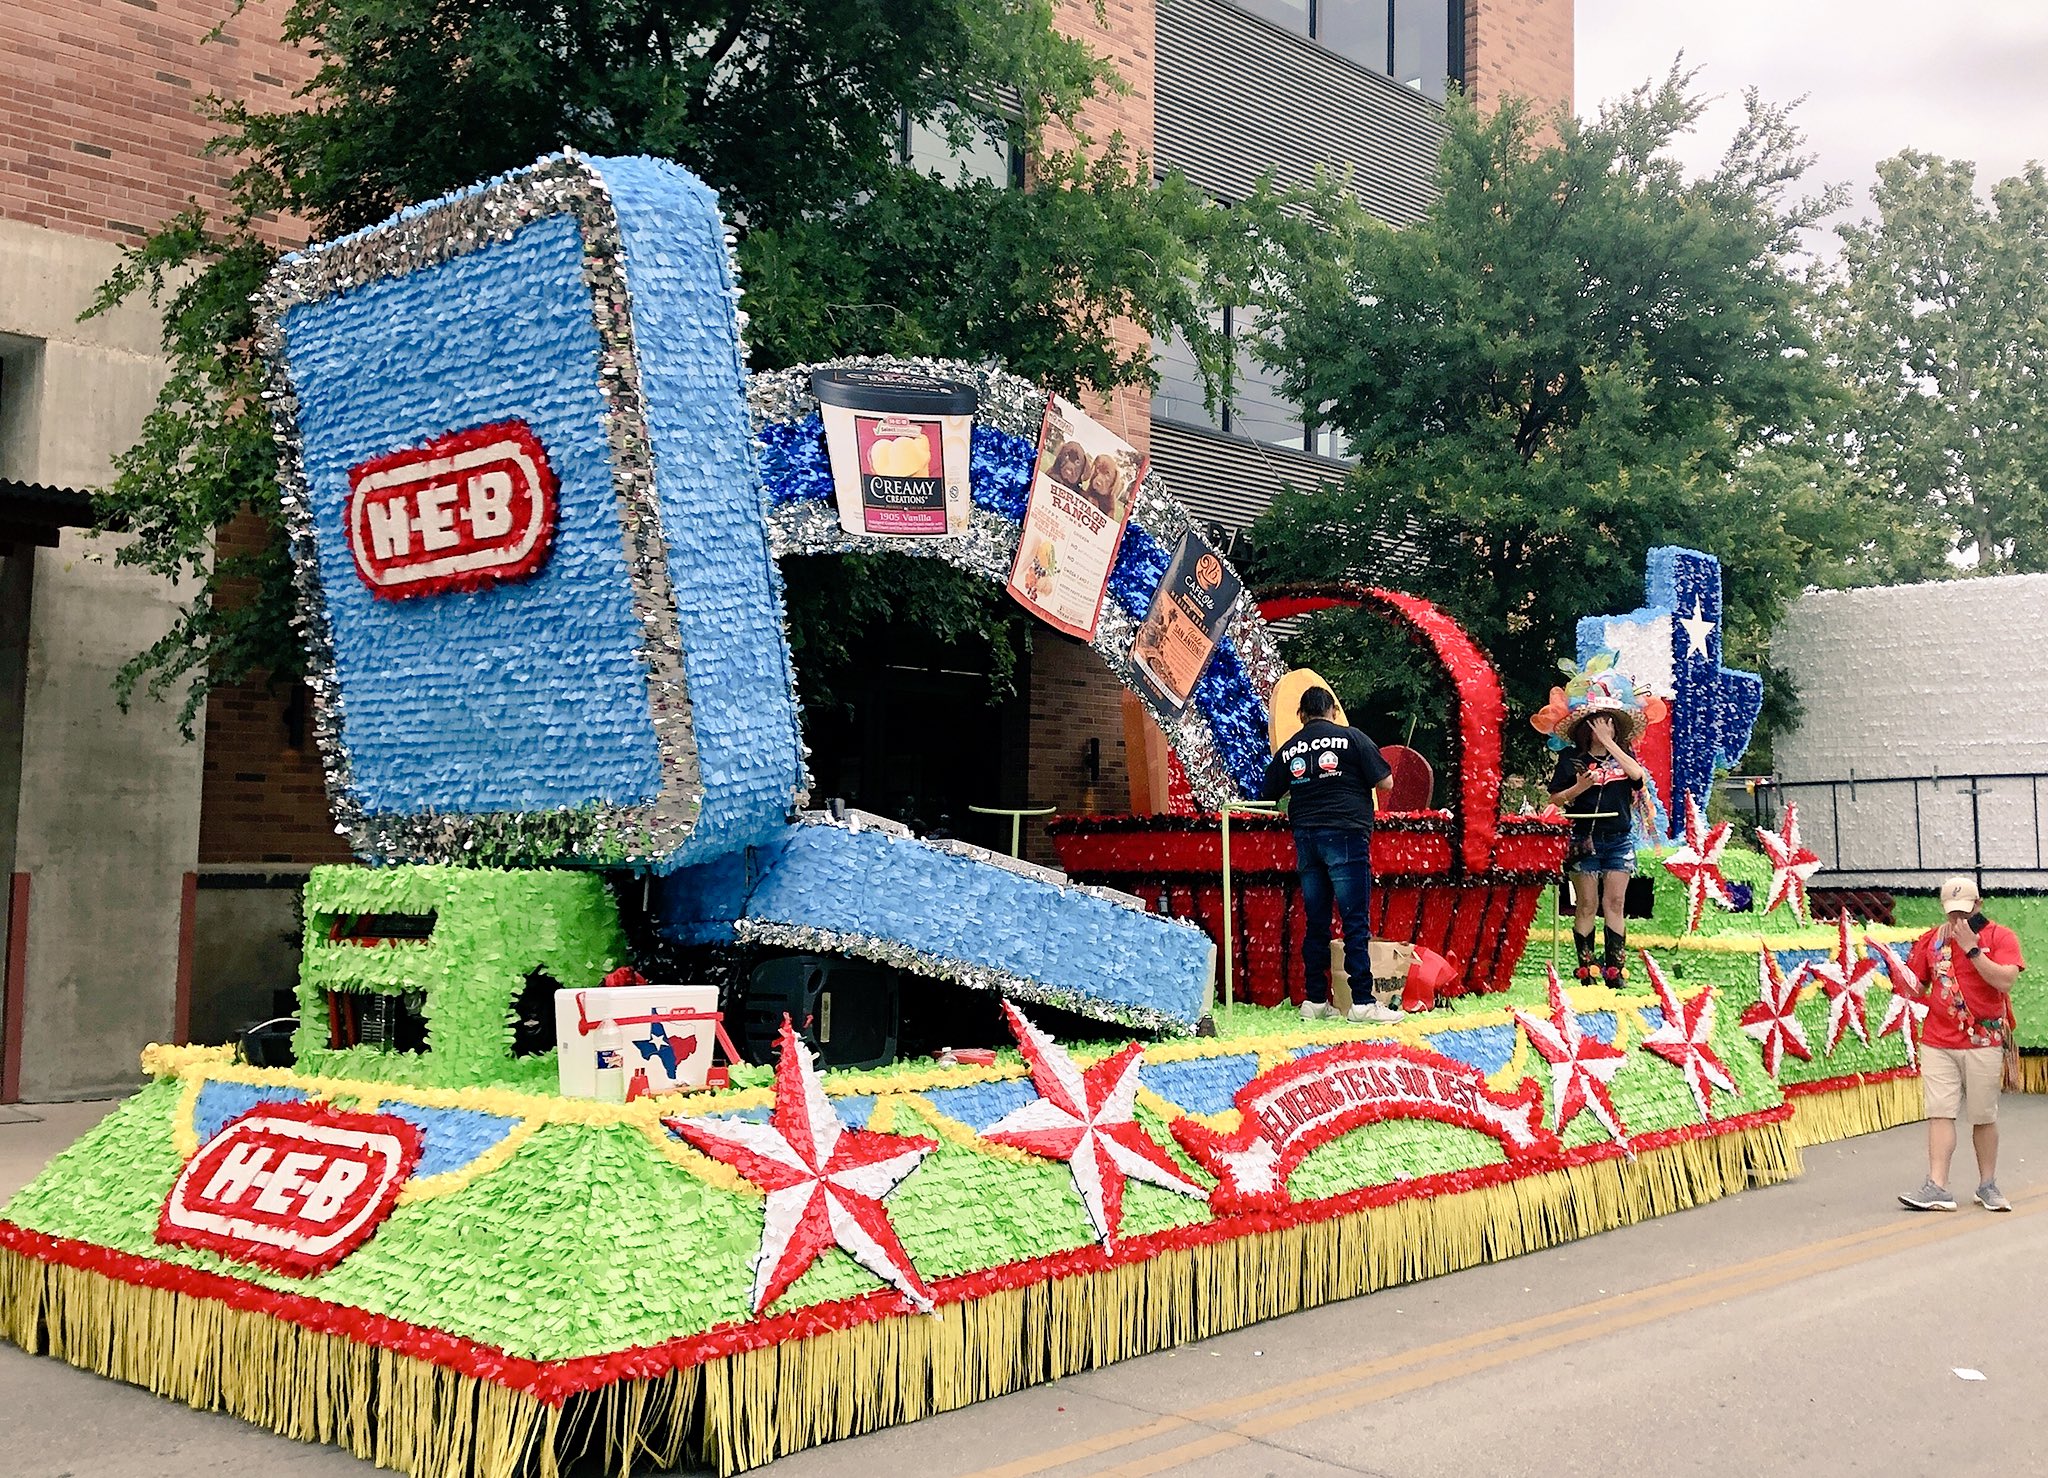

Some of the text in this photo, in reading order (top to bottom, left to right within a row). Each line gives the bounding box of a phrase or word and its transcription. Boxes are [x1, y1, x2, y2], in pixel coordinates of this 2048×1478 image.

[870, 476, 935, 498] CREAMY
[366, 470, 514, 561] H-E-B
[879, 512, 931, 522] 1905 Vanilla
[1050, 484, 1107, 528] HERITAGE
[1051, 495, 1101, 536] RANCH
[1185, 575, 1205, 599] CAFE
[1173, 625, 1185, 639] SAN
[1183, 638, 1205, 658] ANTONIO
[1282, 737, 1349, 764] heb.com
[1333, 1066, 1398, 1100] TEXAS
[1432, 1071, 1479, 1113] BEST
[200, 1142, 368, 1223] H-E-B
